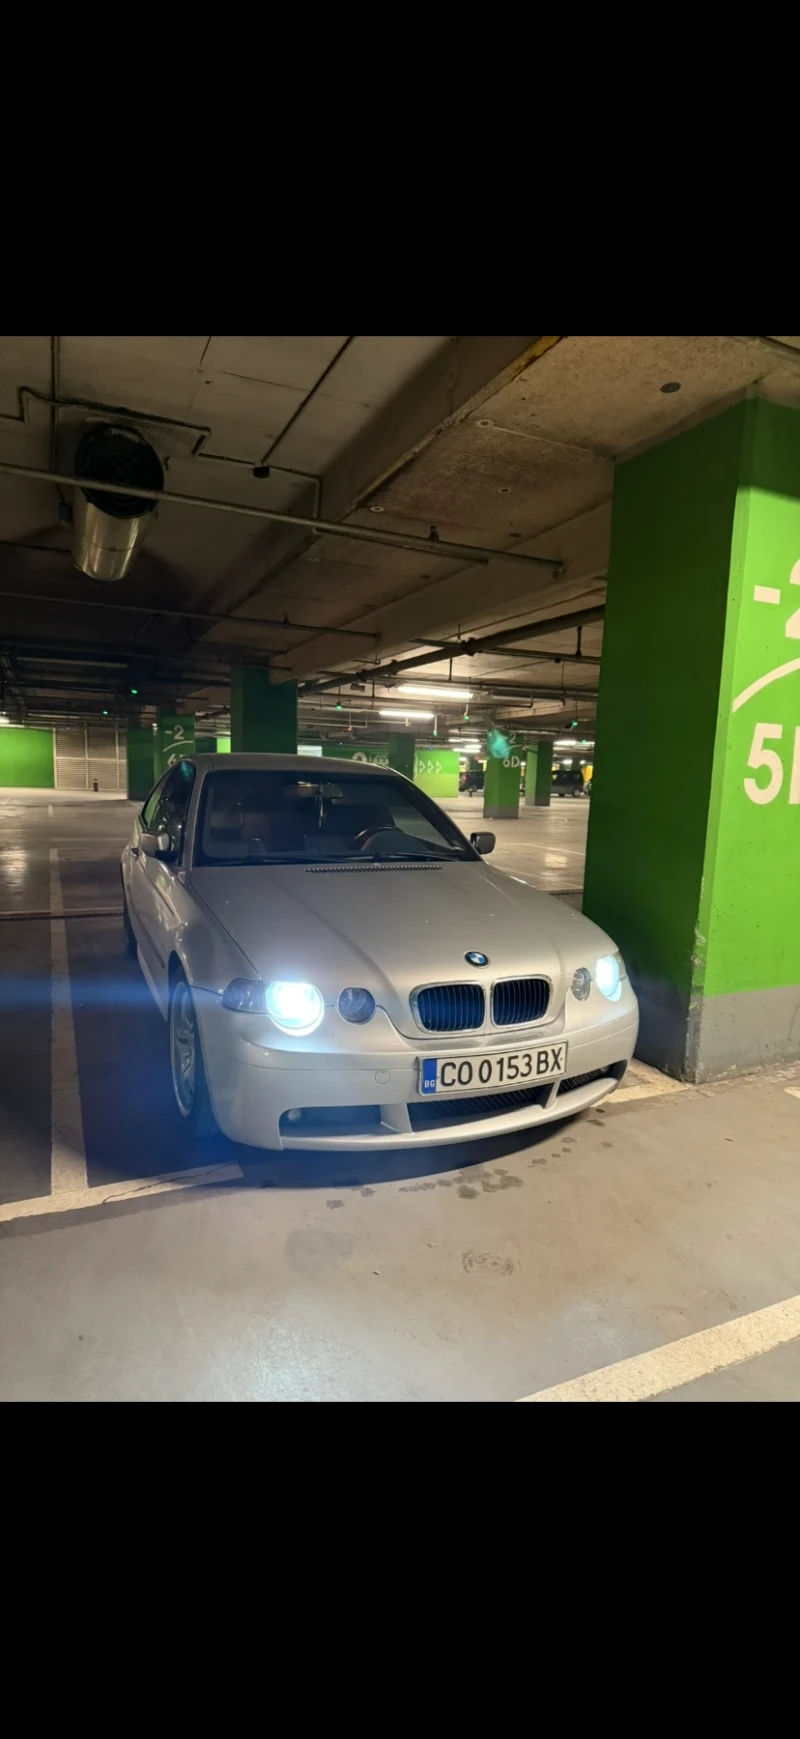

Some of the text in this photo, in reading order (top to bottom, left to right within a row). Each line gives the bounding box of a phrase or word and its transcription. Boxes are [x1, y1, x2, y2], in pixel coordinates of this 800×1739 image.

[165, 725, 184, 739] -2
[503, 756, 520, 767] 6D
[441, 1047, 562, 1087] CO 0153 BX
[424, 1079, 436, 1088] BG
